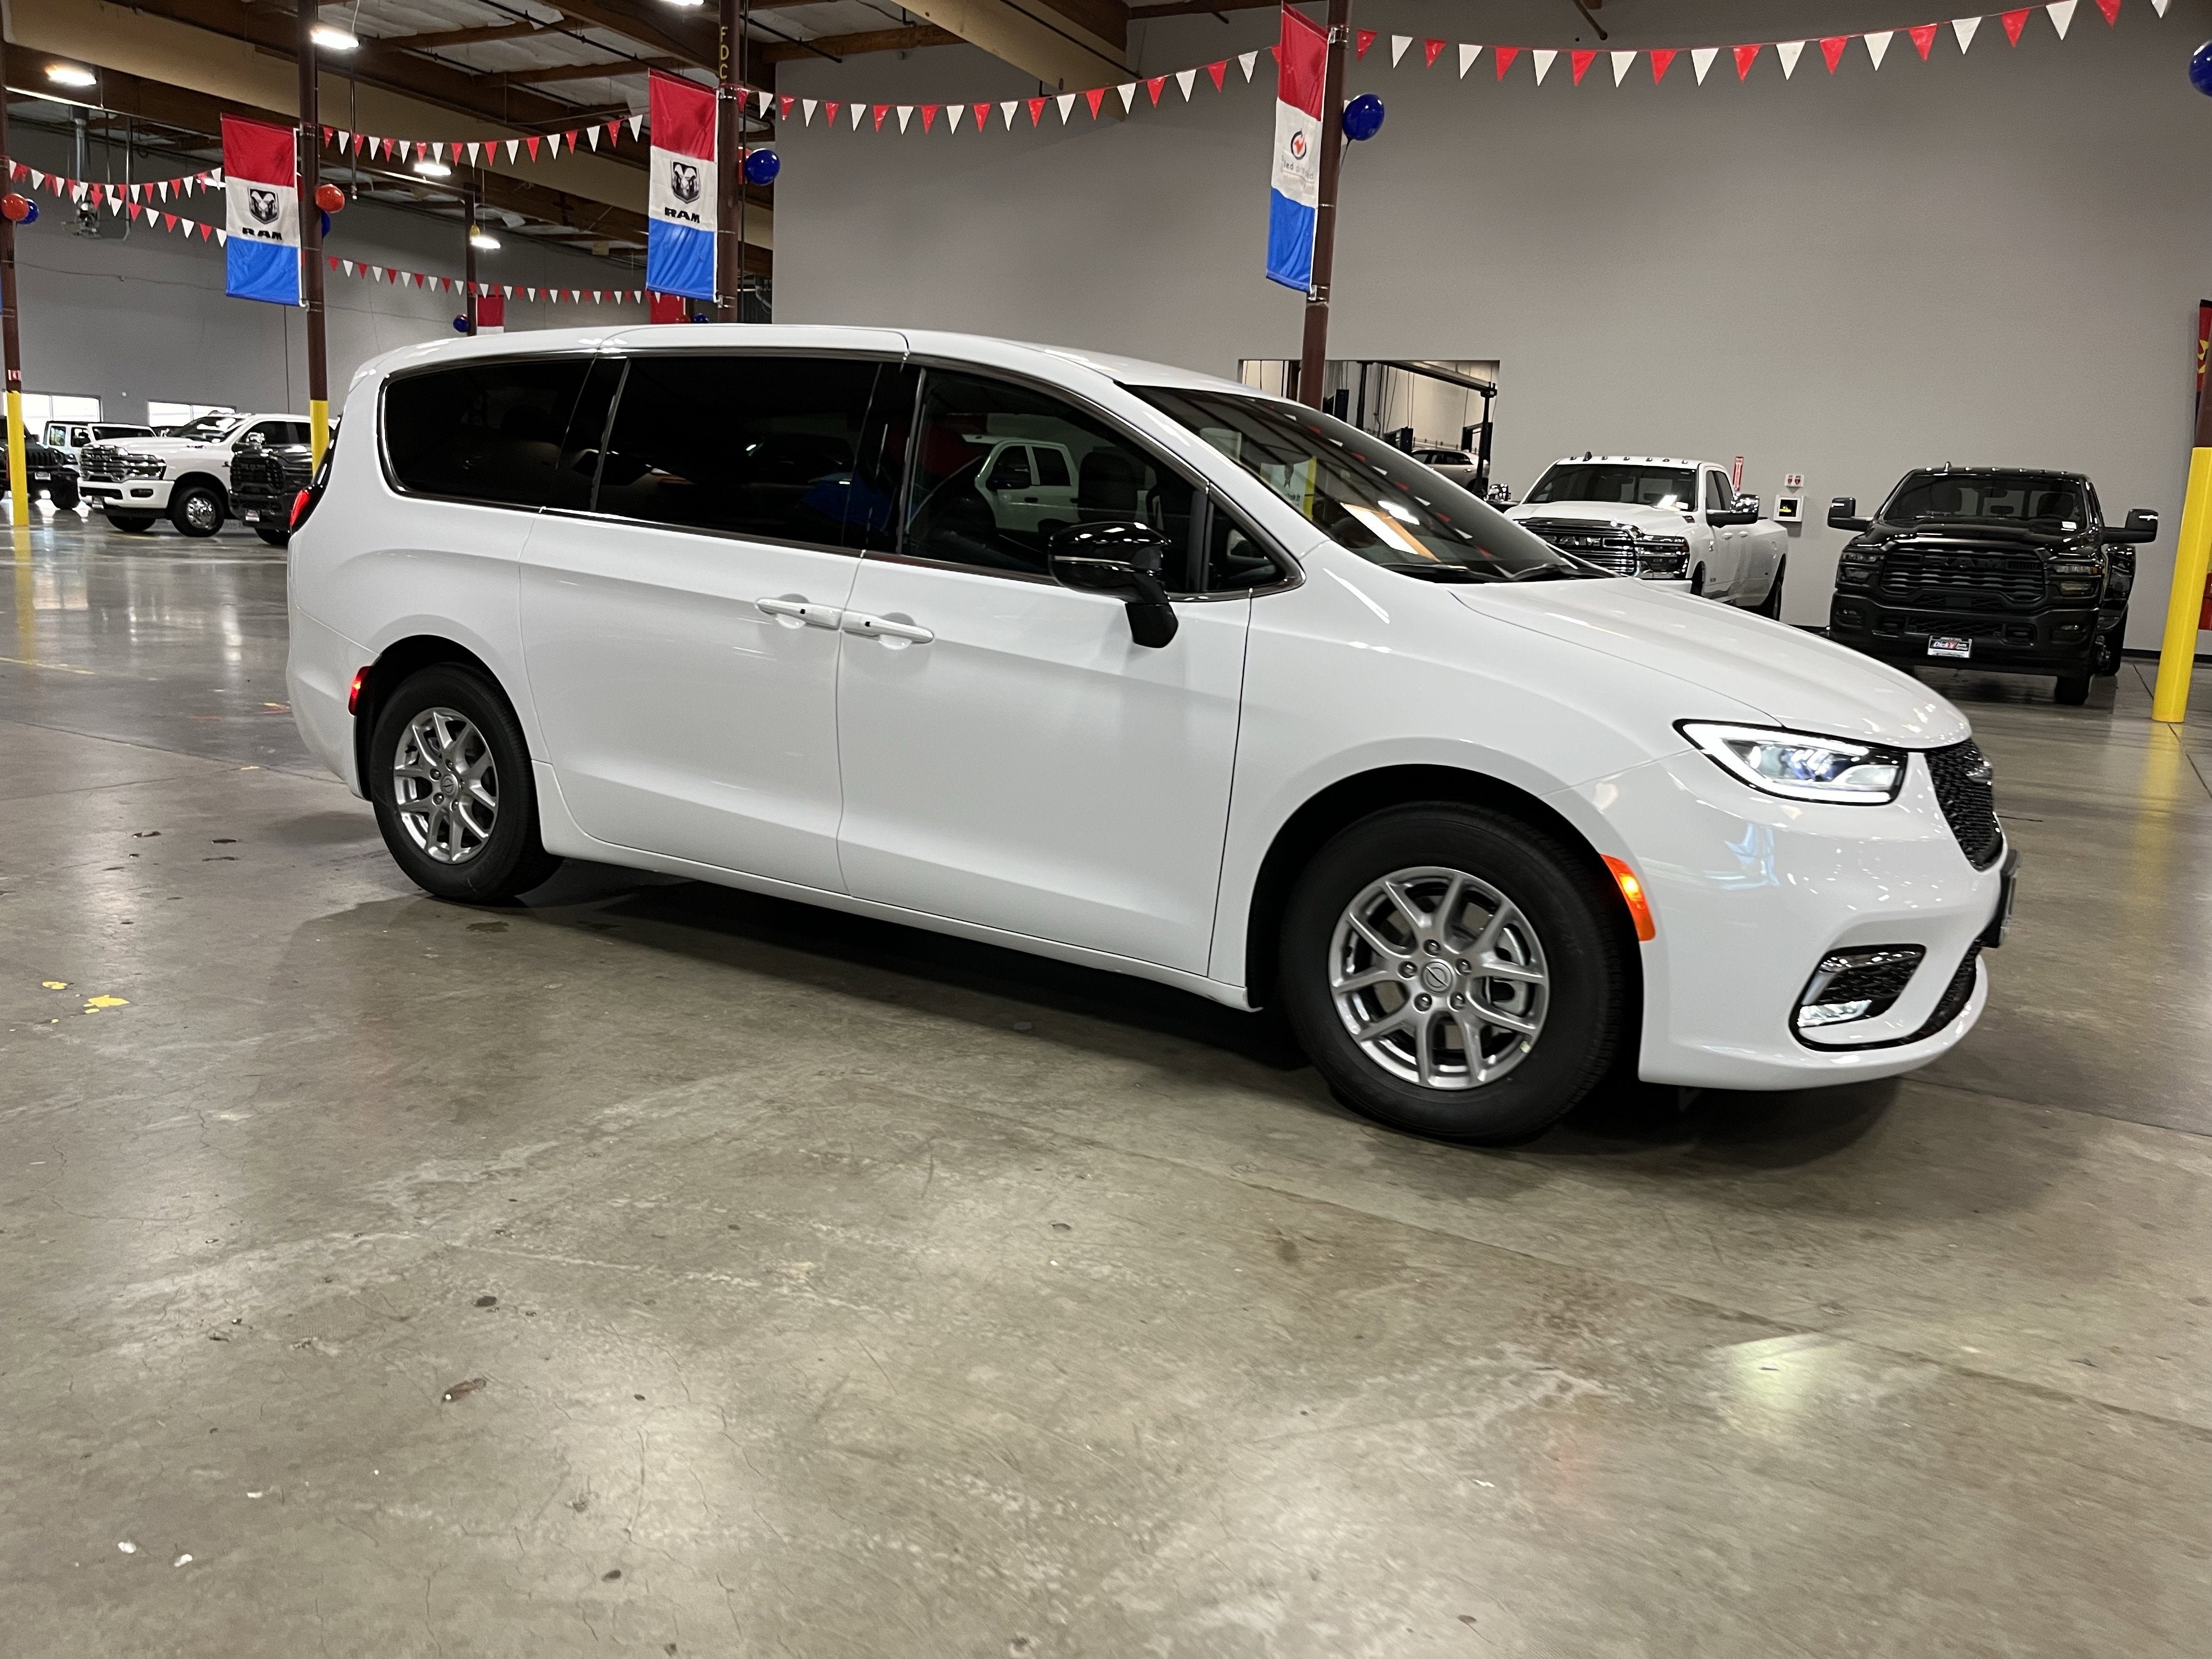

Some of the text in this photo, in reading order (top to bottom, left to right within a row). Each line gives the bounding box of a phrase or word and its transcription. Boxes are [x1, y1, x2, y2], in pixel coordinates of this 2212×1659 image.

[720, 26, 729, 80] FDC
[664, 207, 700, 223] RAM
[242, 227, 283, 240] RAM
